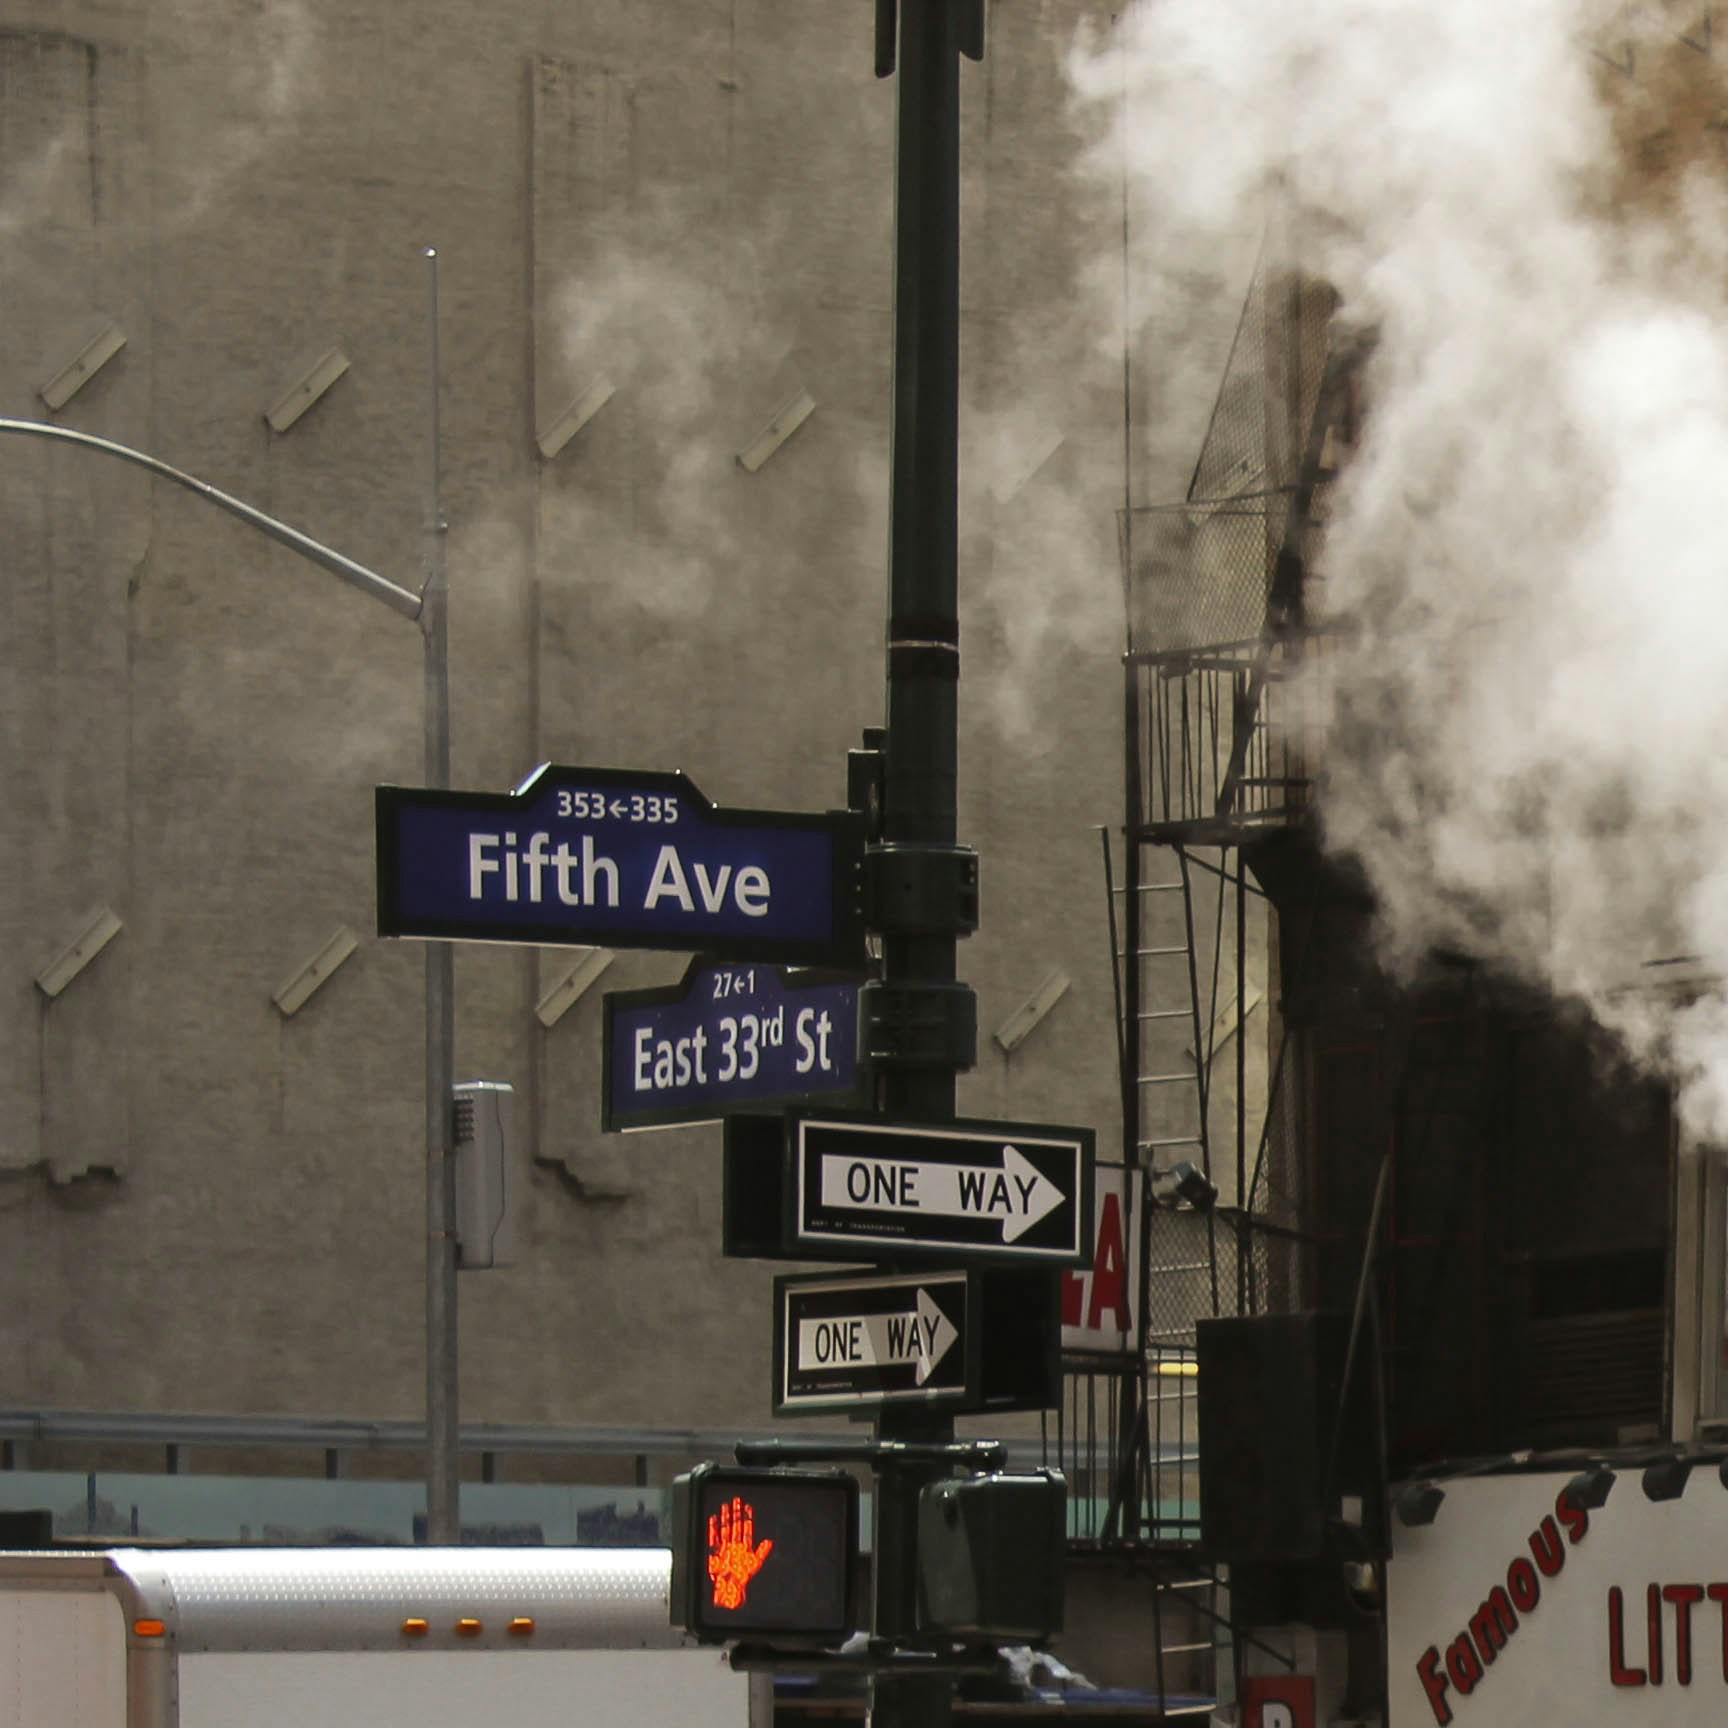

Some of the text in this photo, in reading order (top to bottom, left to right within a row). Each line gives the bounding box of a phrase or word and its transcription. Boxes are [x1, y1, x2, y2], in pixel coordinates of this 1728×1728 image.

[557, 791, 680, 824] 353 335
[468, 831, 771, 916] Fifth Ave
[713, 972, 734, 999] 27
[634, 1006, 832, 1092] East 33rd St
[847, 1162, 1038, 1215] ONE WAY
[816, 1315, 941, 1363] ONE WAY
